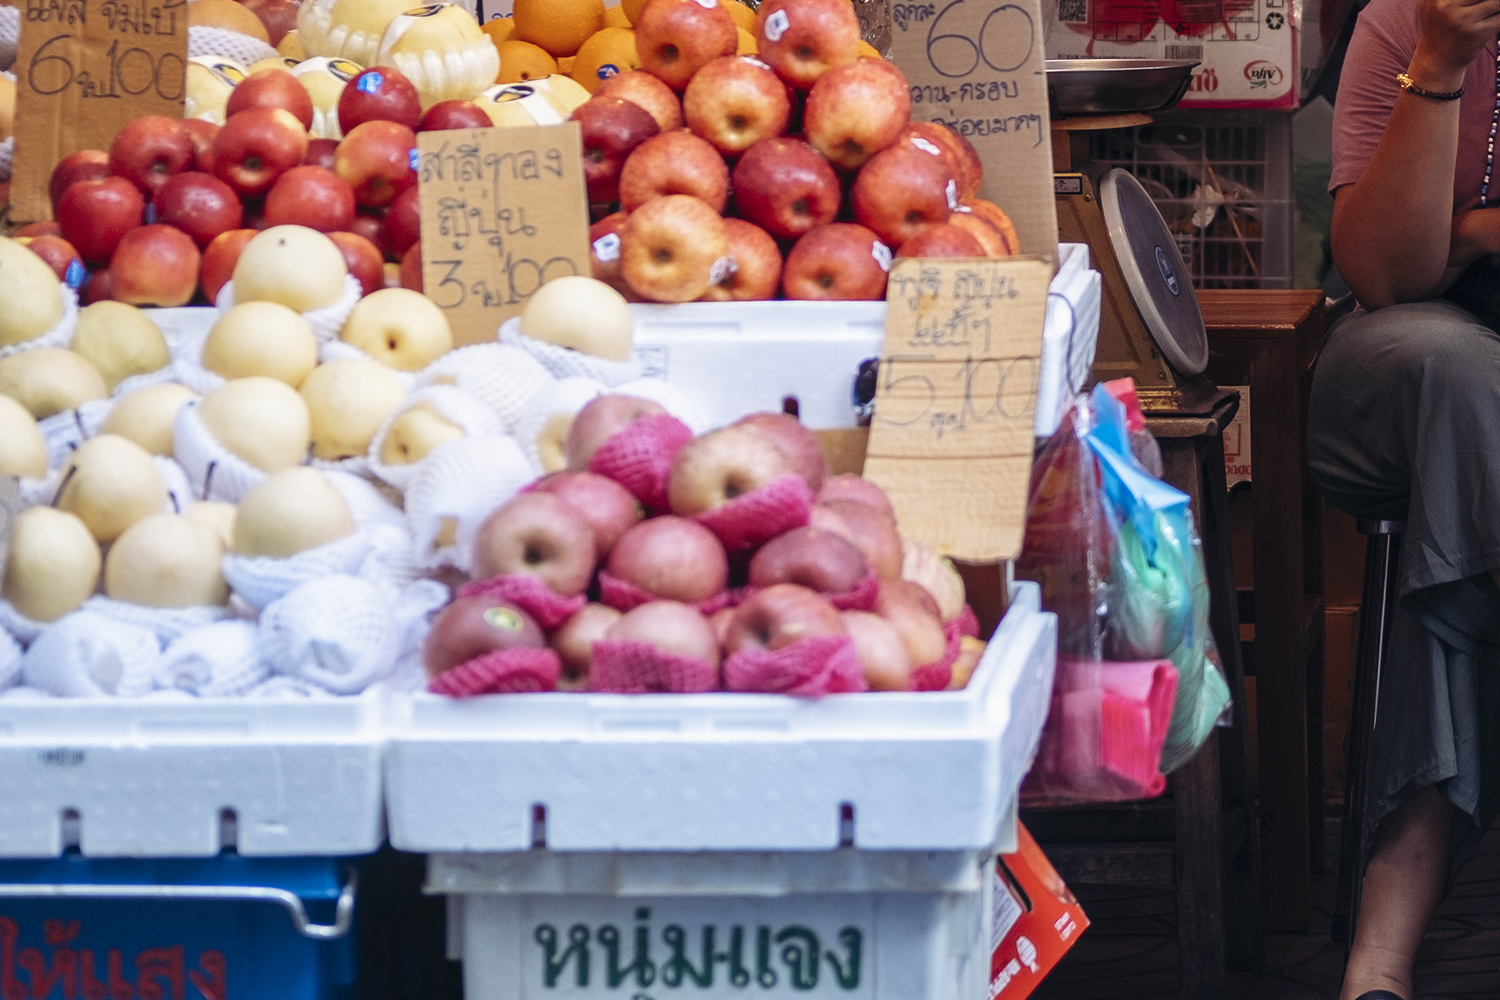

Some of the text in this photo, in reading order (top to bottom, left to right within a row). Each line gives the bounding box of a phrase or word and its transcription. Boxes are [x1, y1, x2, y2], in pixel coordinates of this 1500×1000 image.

[28, 34, 74, 96] 6
[1251, 67, 1277, 81] Alfa
[911, 80, 1019, 103] วาน-กรอบ
[430, 259, 468, 309] 3
